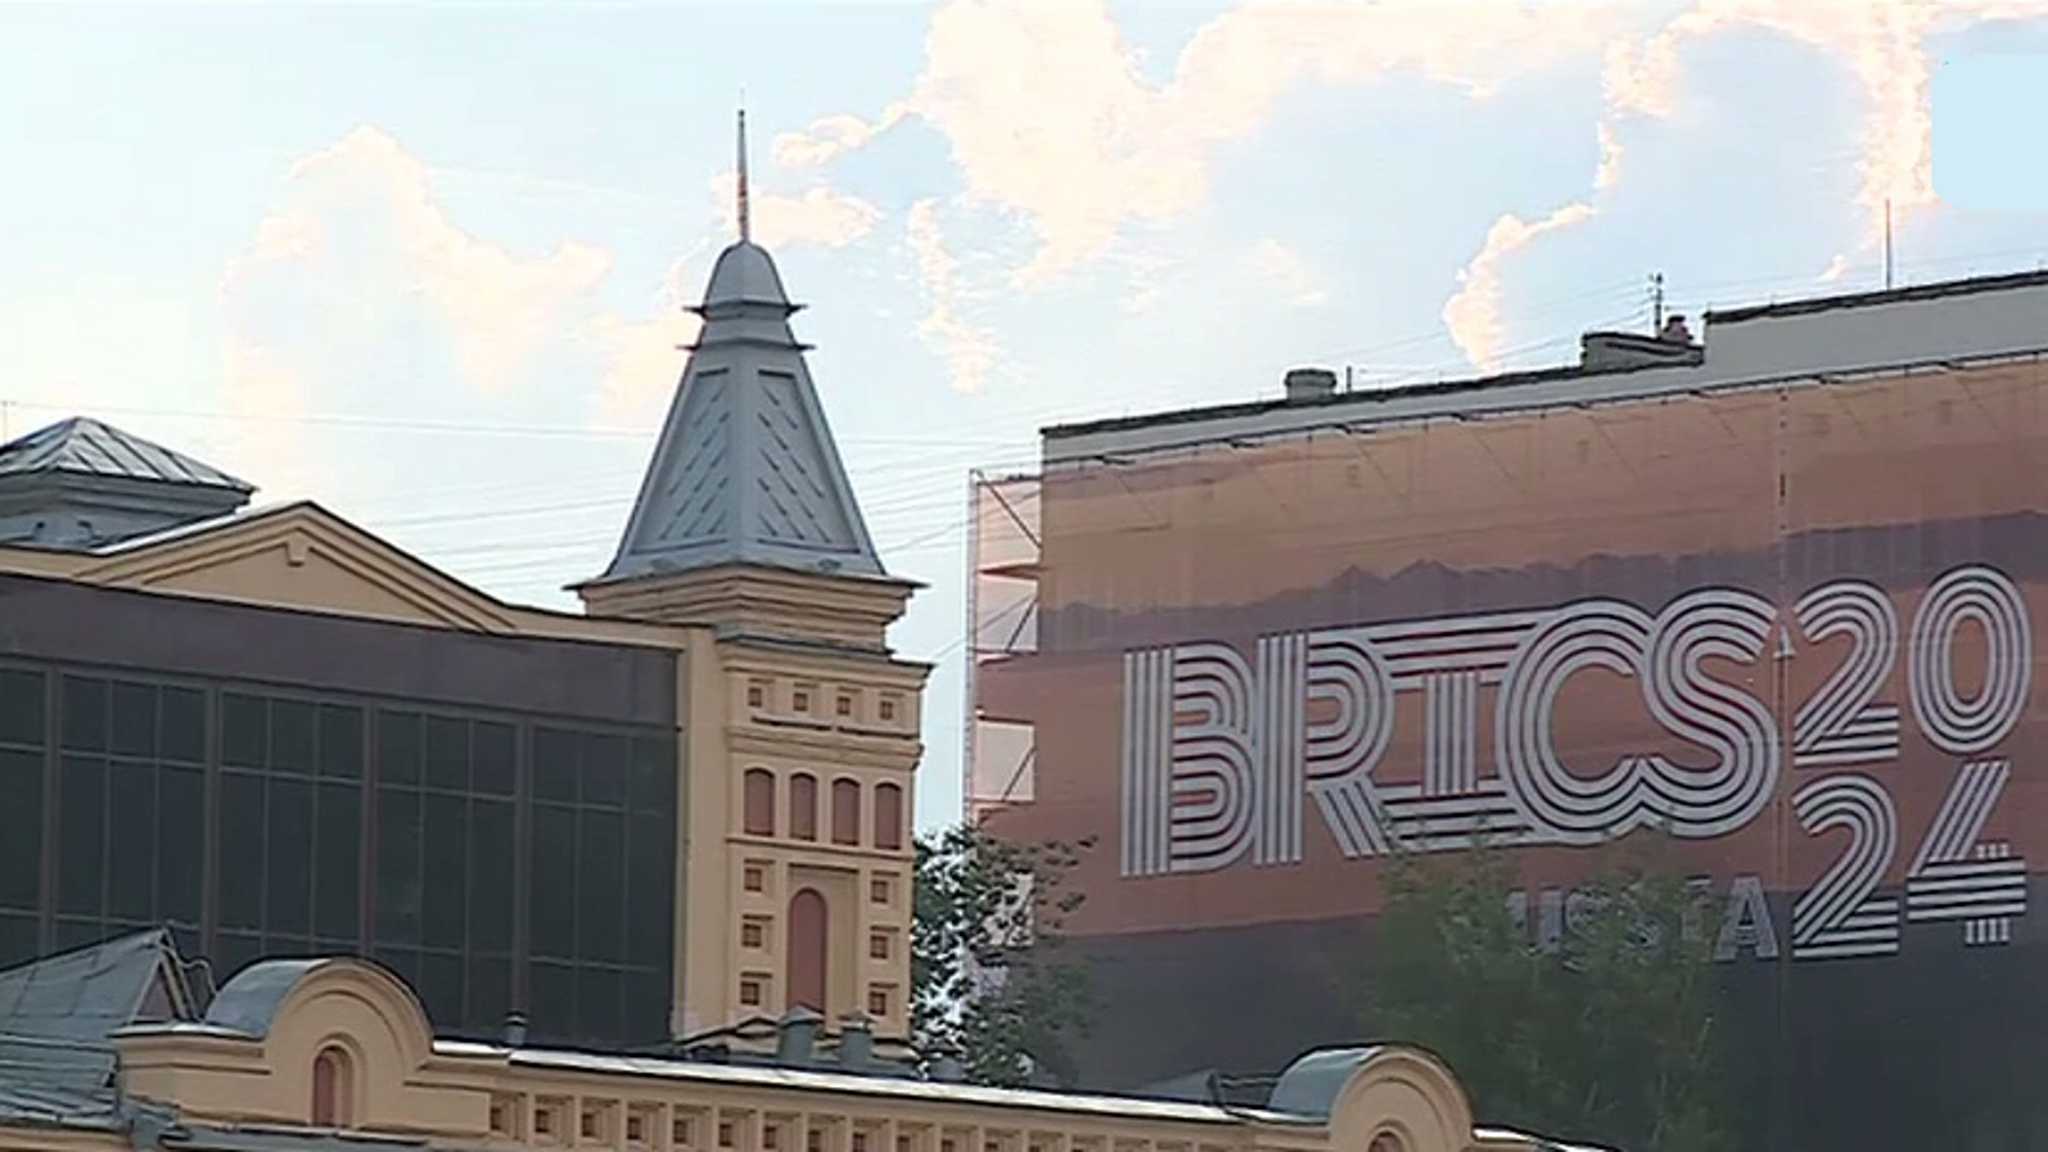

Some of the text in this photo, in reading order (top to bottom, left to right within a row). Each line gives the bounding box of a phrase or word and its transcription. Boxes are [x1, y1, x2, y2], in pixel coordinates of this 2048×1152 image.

[1120, 588, 1779, 876] BRICS
[1793, 564, 2032, 766] 20
[1793, 760, 2028, 960] 24
